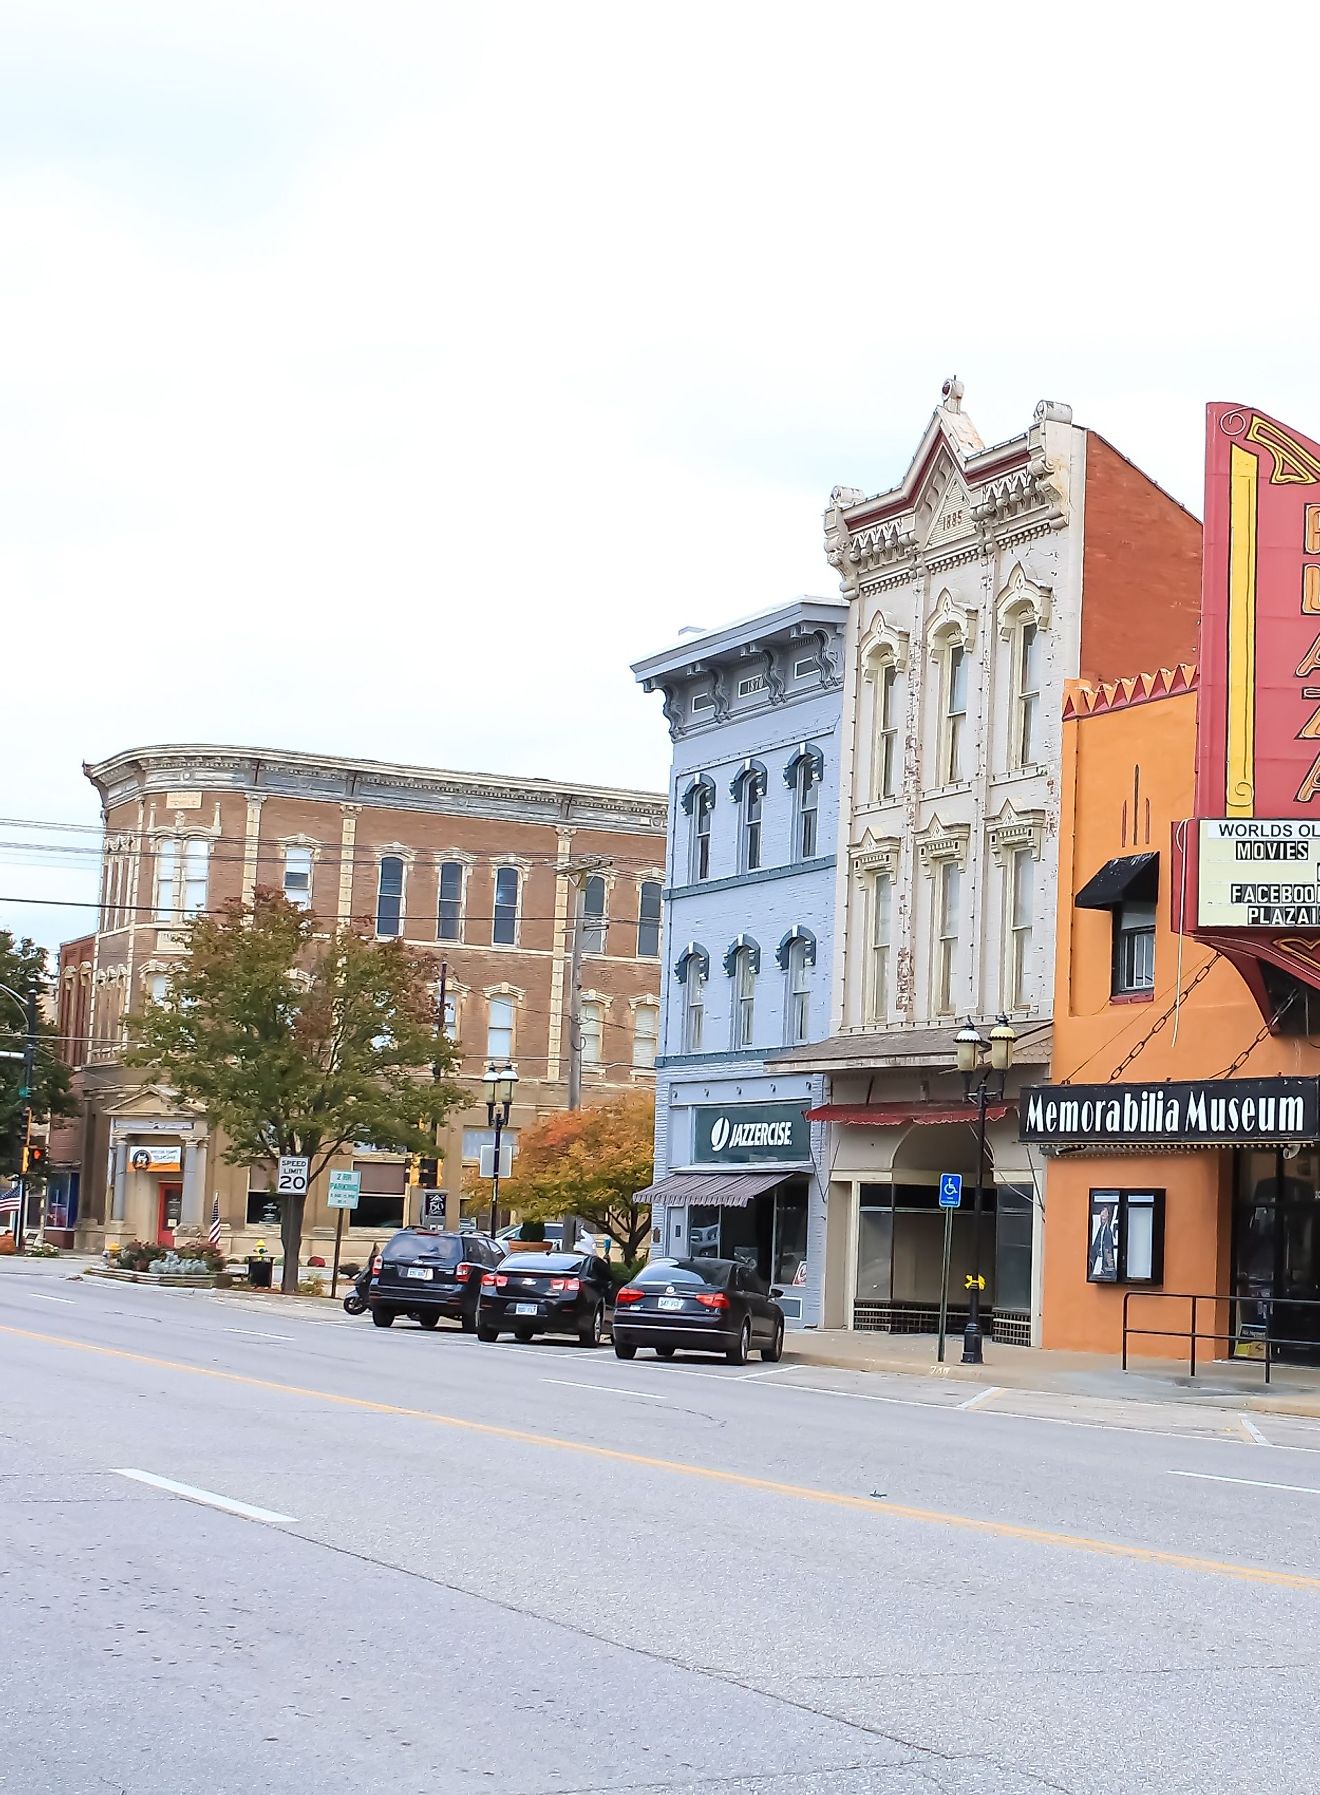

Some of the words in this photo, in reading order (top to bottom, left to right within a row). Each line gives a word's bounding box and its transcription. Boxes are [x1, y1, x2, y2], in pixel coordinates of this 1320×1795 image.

[942, 510, 963, 531] 1885
[747, 677, 764, 693] 1870
[1219, 824, 1293, 838] WORLDS
[1236, 841, 1309, 860] MOVIES
[1026, 1090, 1179, 1132] Memorabilia
[1185, 1090, 1304, 1132] Museum
[729, 1121, 792, 1148] JAZZERCISE
[279, 1175, 305, 1190] 20
